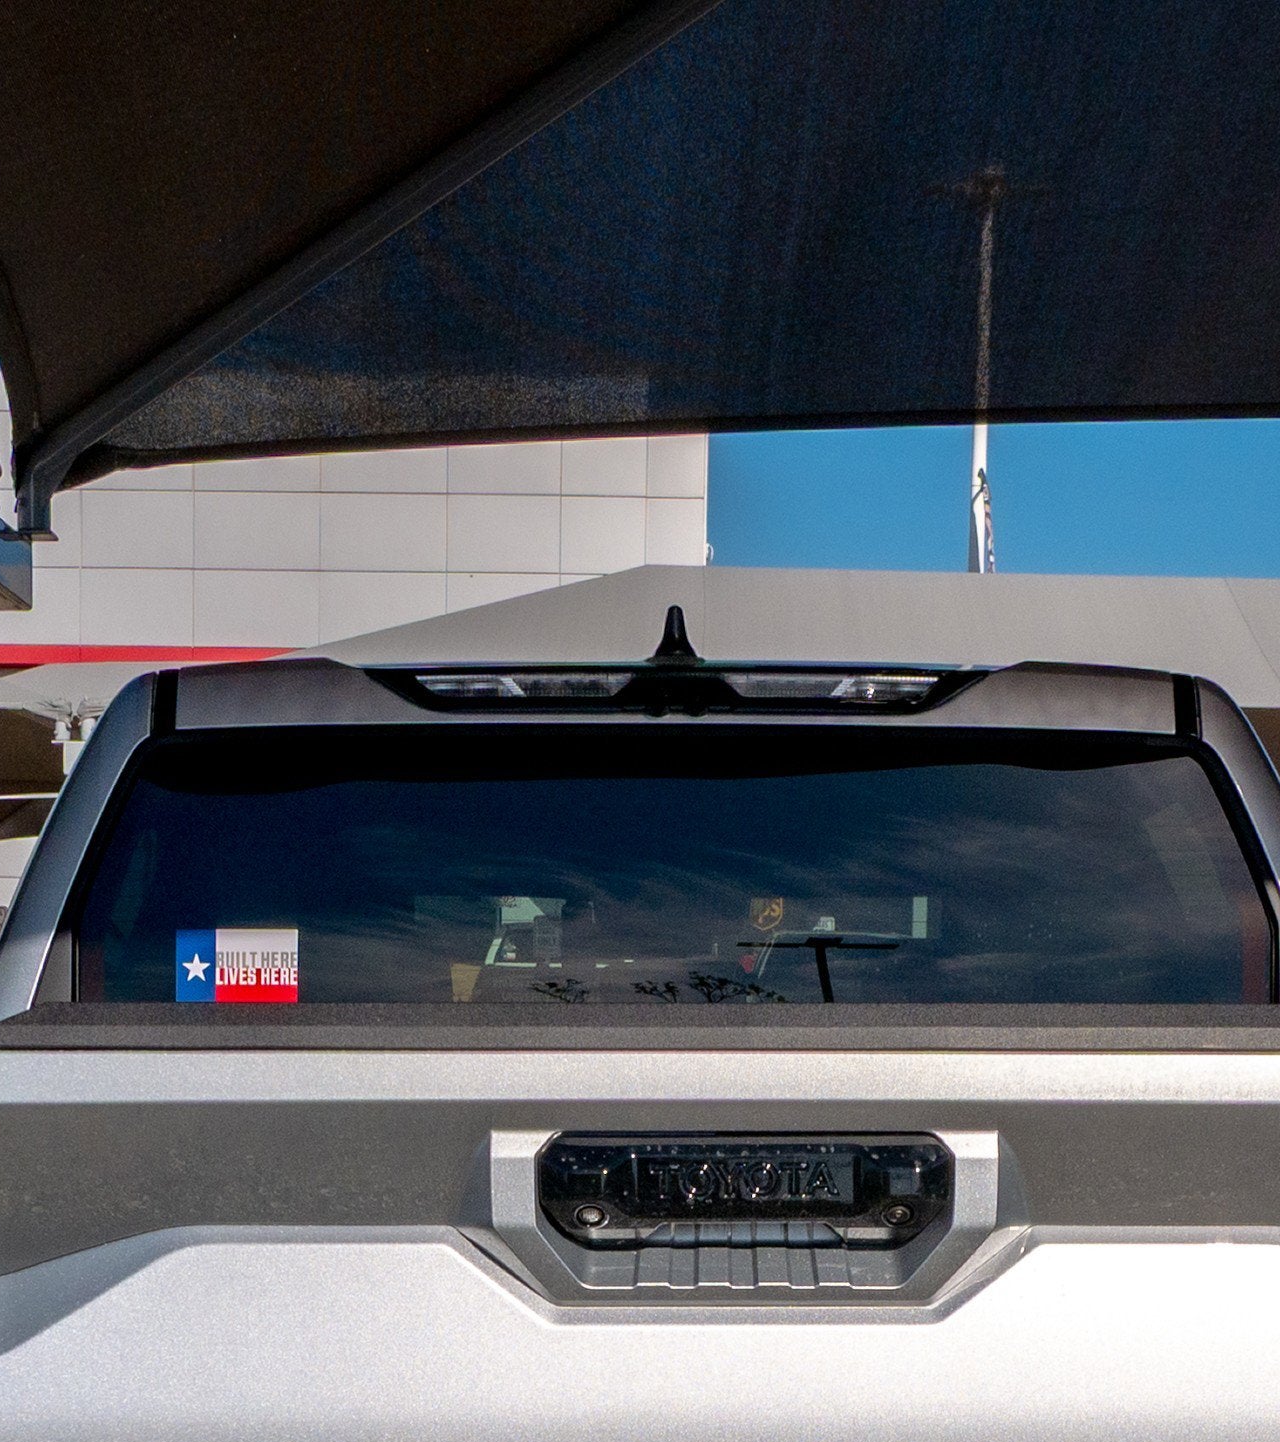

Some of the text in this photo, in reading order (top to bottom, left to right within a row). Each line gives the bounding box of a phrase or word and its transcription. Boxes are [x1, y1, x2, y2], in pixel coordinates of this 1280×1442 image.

[216, 951, 298, 969] BUILT HERE
[216, 967, 298, 985] LIVES HERE
[649, 1162, 841, 1199] TOYOTA
